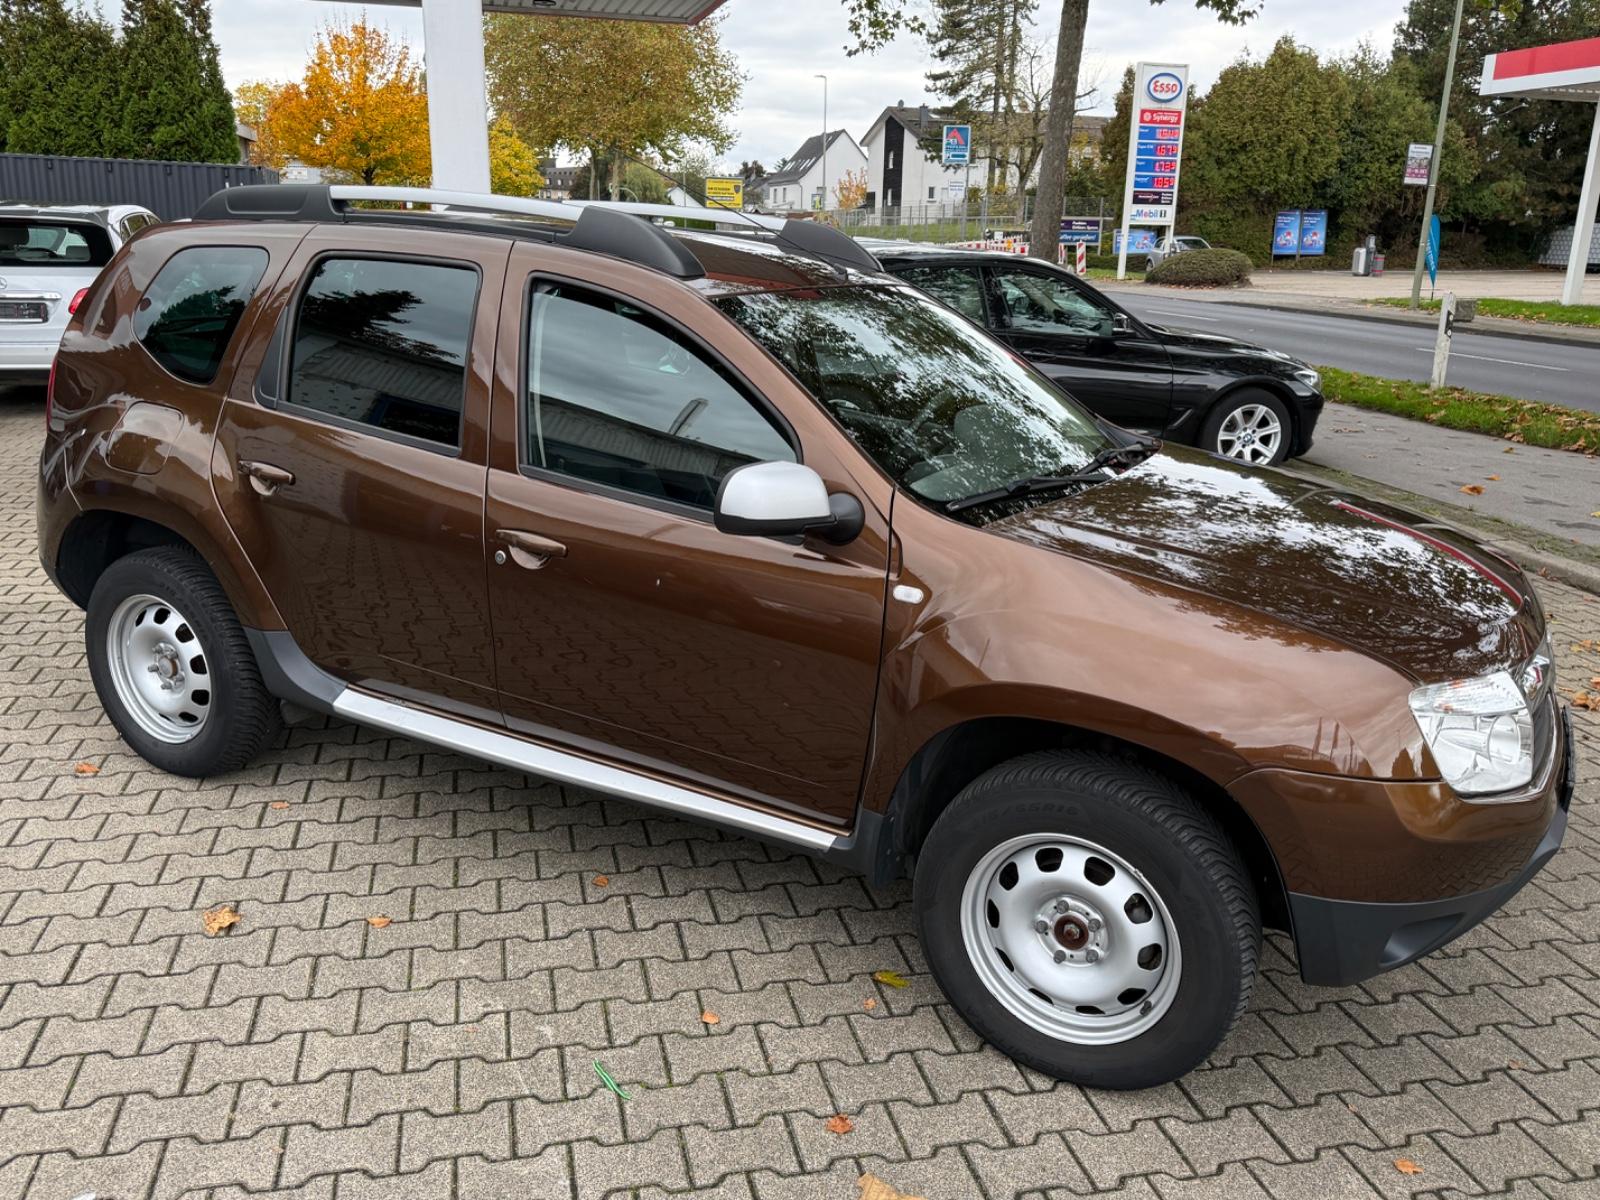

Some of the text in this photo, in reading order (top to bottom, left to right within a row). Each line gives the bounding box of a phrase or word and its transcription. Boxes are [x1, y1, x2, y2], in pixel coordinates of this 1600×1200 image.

[1153, 80, 1178, 93] Esso
[1152, 112, 1179, 123] Synergy
[1135, 209, 1159, 218] Mobil
